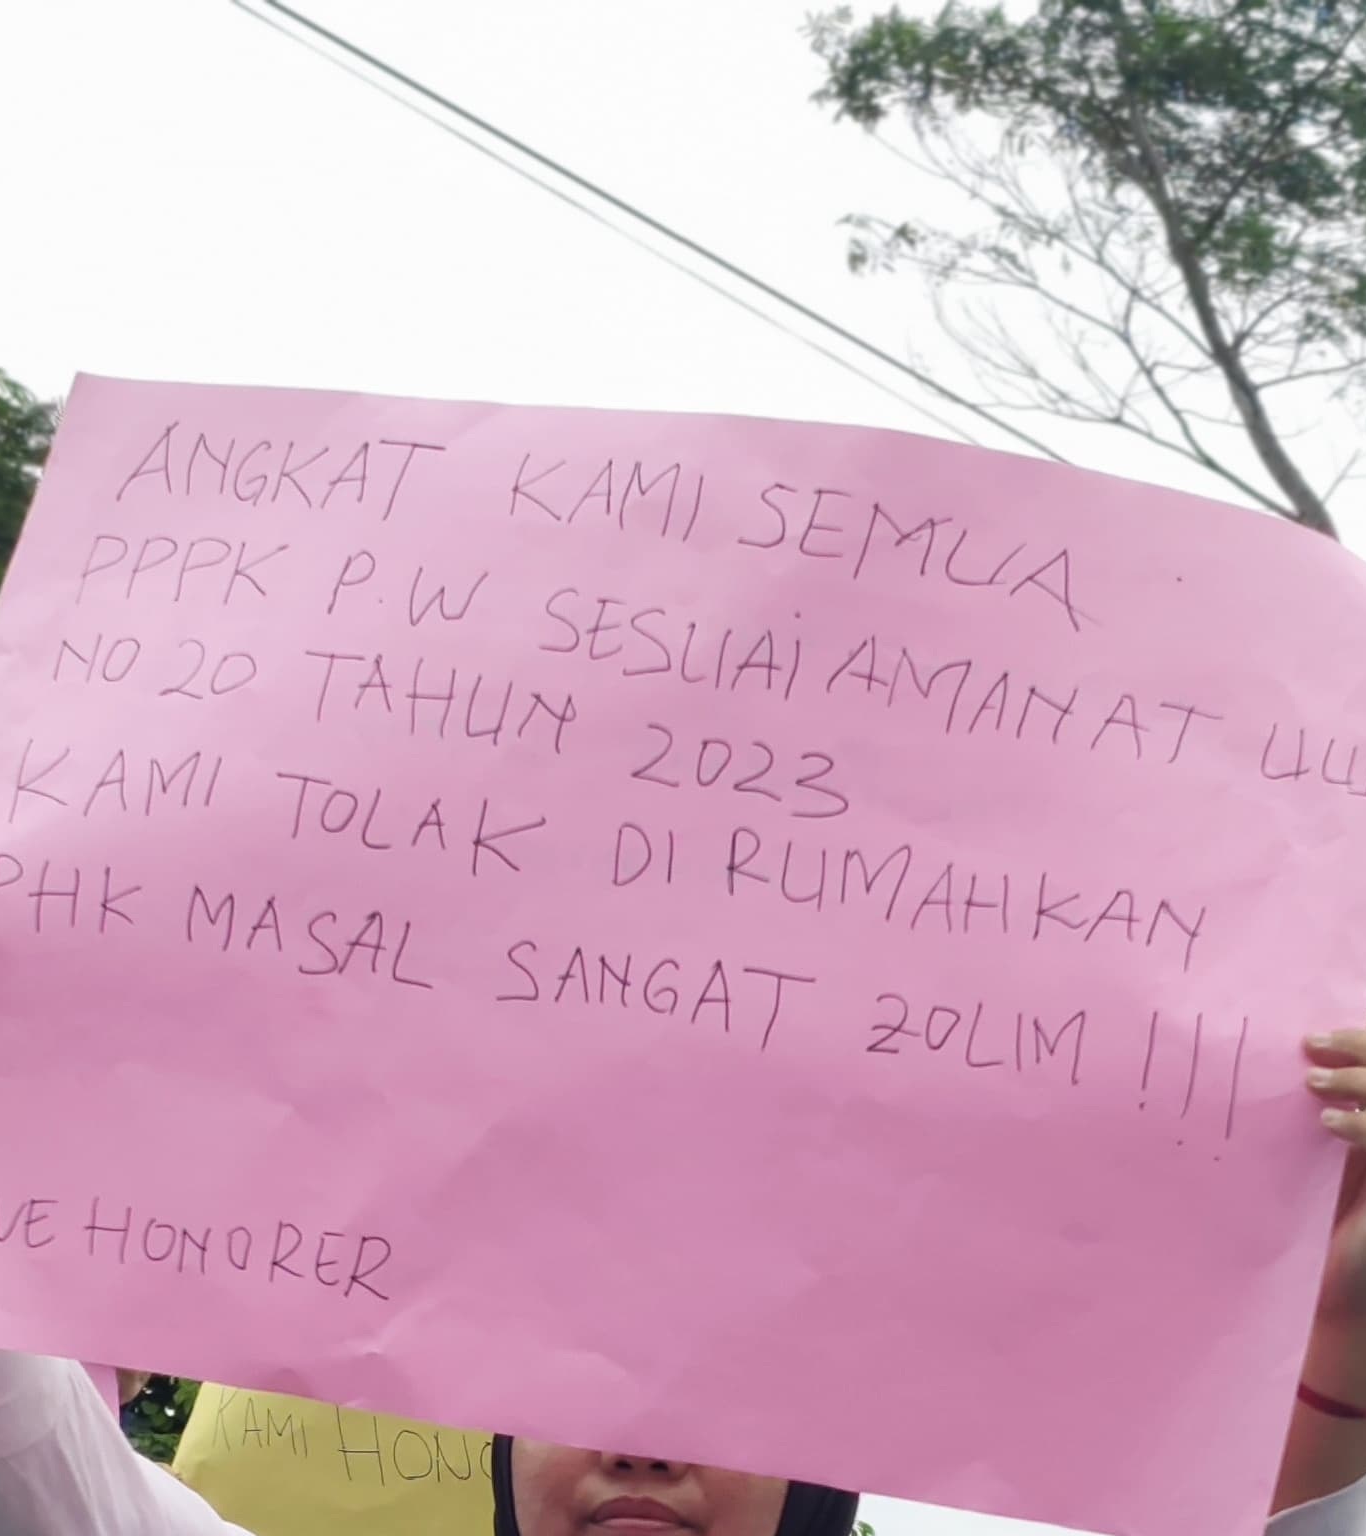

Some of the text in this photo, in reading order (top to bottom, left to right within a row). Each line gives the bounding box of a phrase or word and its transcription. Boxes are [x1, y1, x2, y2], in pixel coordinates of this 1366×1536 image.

[76, 534, 290, 604] PPPK
[117, 421, 1097, 631] ANGKAT KAMI SEMUA
[52, 633, 849, 818] NO 20 TAHUN 2023
[9, 738, 1206, 972] KAMI TOLAK DI RUMAHKAN
[185, 884, 434, 990] MASAL
[496, 941, 816, 1052] SANGAT
[865, 993, 1088, 1086] ZOLIM
[212, 1389, 307, 1459] KAMI
